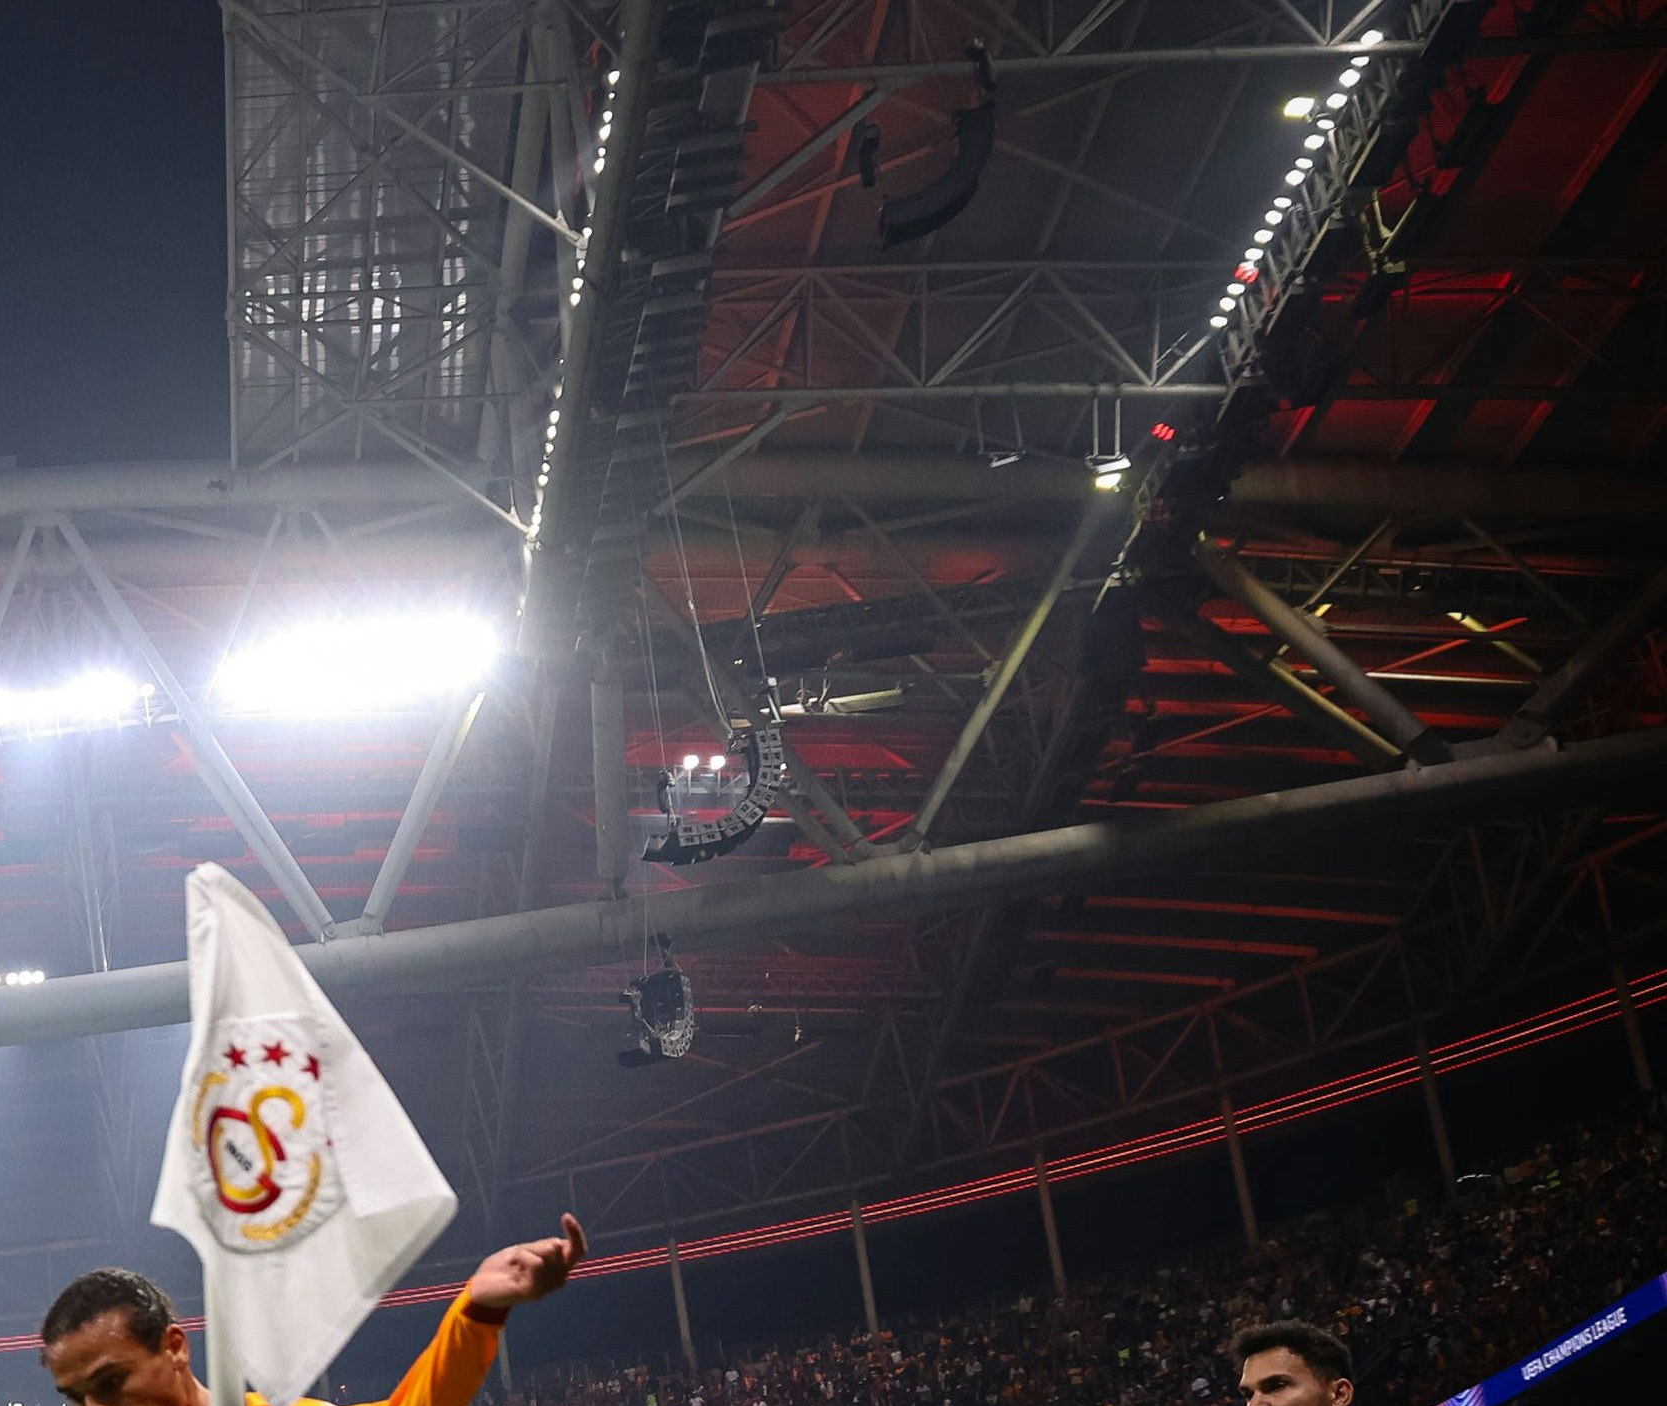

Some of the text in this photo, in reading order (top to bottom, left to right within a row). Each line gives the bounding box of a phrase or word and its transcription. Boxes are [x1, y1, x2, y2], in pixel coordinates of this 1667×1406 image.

[1521, 1307, 1627, 1380] UEFA CHAMPIONS LEAGUE
